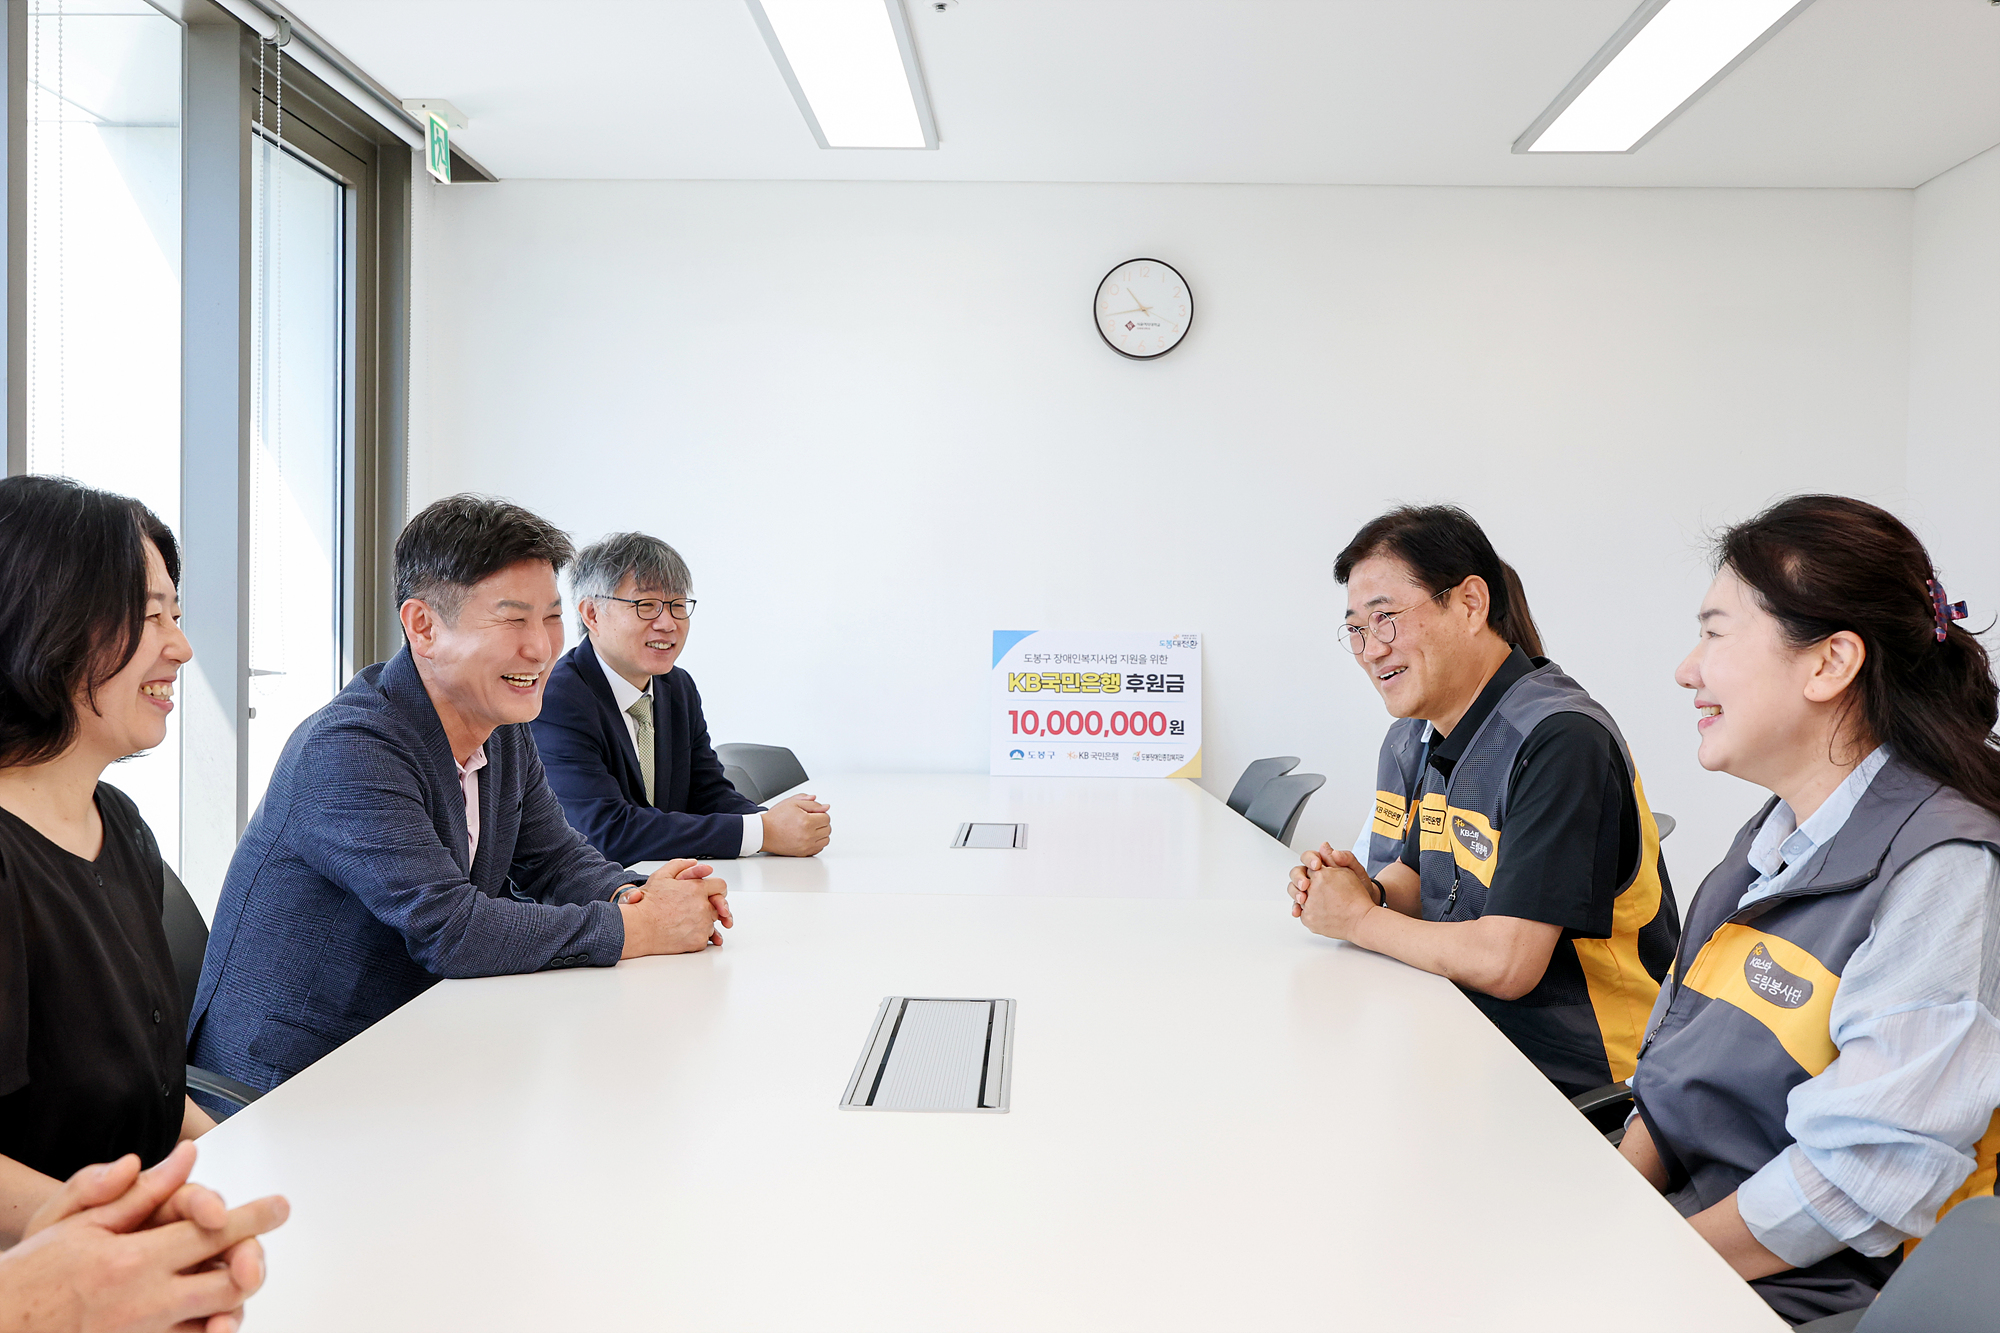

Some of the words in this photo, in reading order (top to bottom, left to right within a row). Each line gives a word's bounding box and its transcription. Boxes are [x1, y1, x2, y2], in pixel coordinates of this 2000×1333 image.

[1123, 271, 1131, 282] 11
[1139, 266, 1150, 278] 12
[1107, 283, 1120, 296] 10
[1173, 286, 1181, 298] 2
[1178, 304, 1186, 317] 3
[1107, 319, 1116, 332] 8
[1171, 323, 1179, 334] 4
[1120, 334, 1128, 346] 7
[1157, 336, 1165, 349] 5
[1137, 340, 1146, 353] 6
[1159, 639, 1198, 649] 도봉대전환
[1024, 654, 1051, 664] 도봉구
[1053, 654, 1118, 664] 장애인복지사업
[1120, 654, 1147, 665] 지원을
[1149, 655, 1169, 665] 위한
[1008, 672, 1122, 693] KB국민은행
[1125, 673, 1185, 693] 후원금
[1027, 751, 1056, 760] 도봉구
[1749, 956, 1773, 973] KB스타
[1750, 973, 1802, 1005] 드림봉사단
